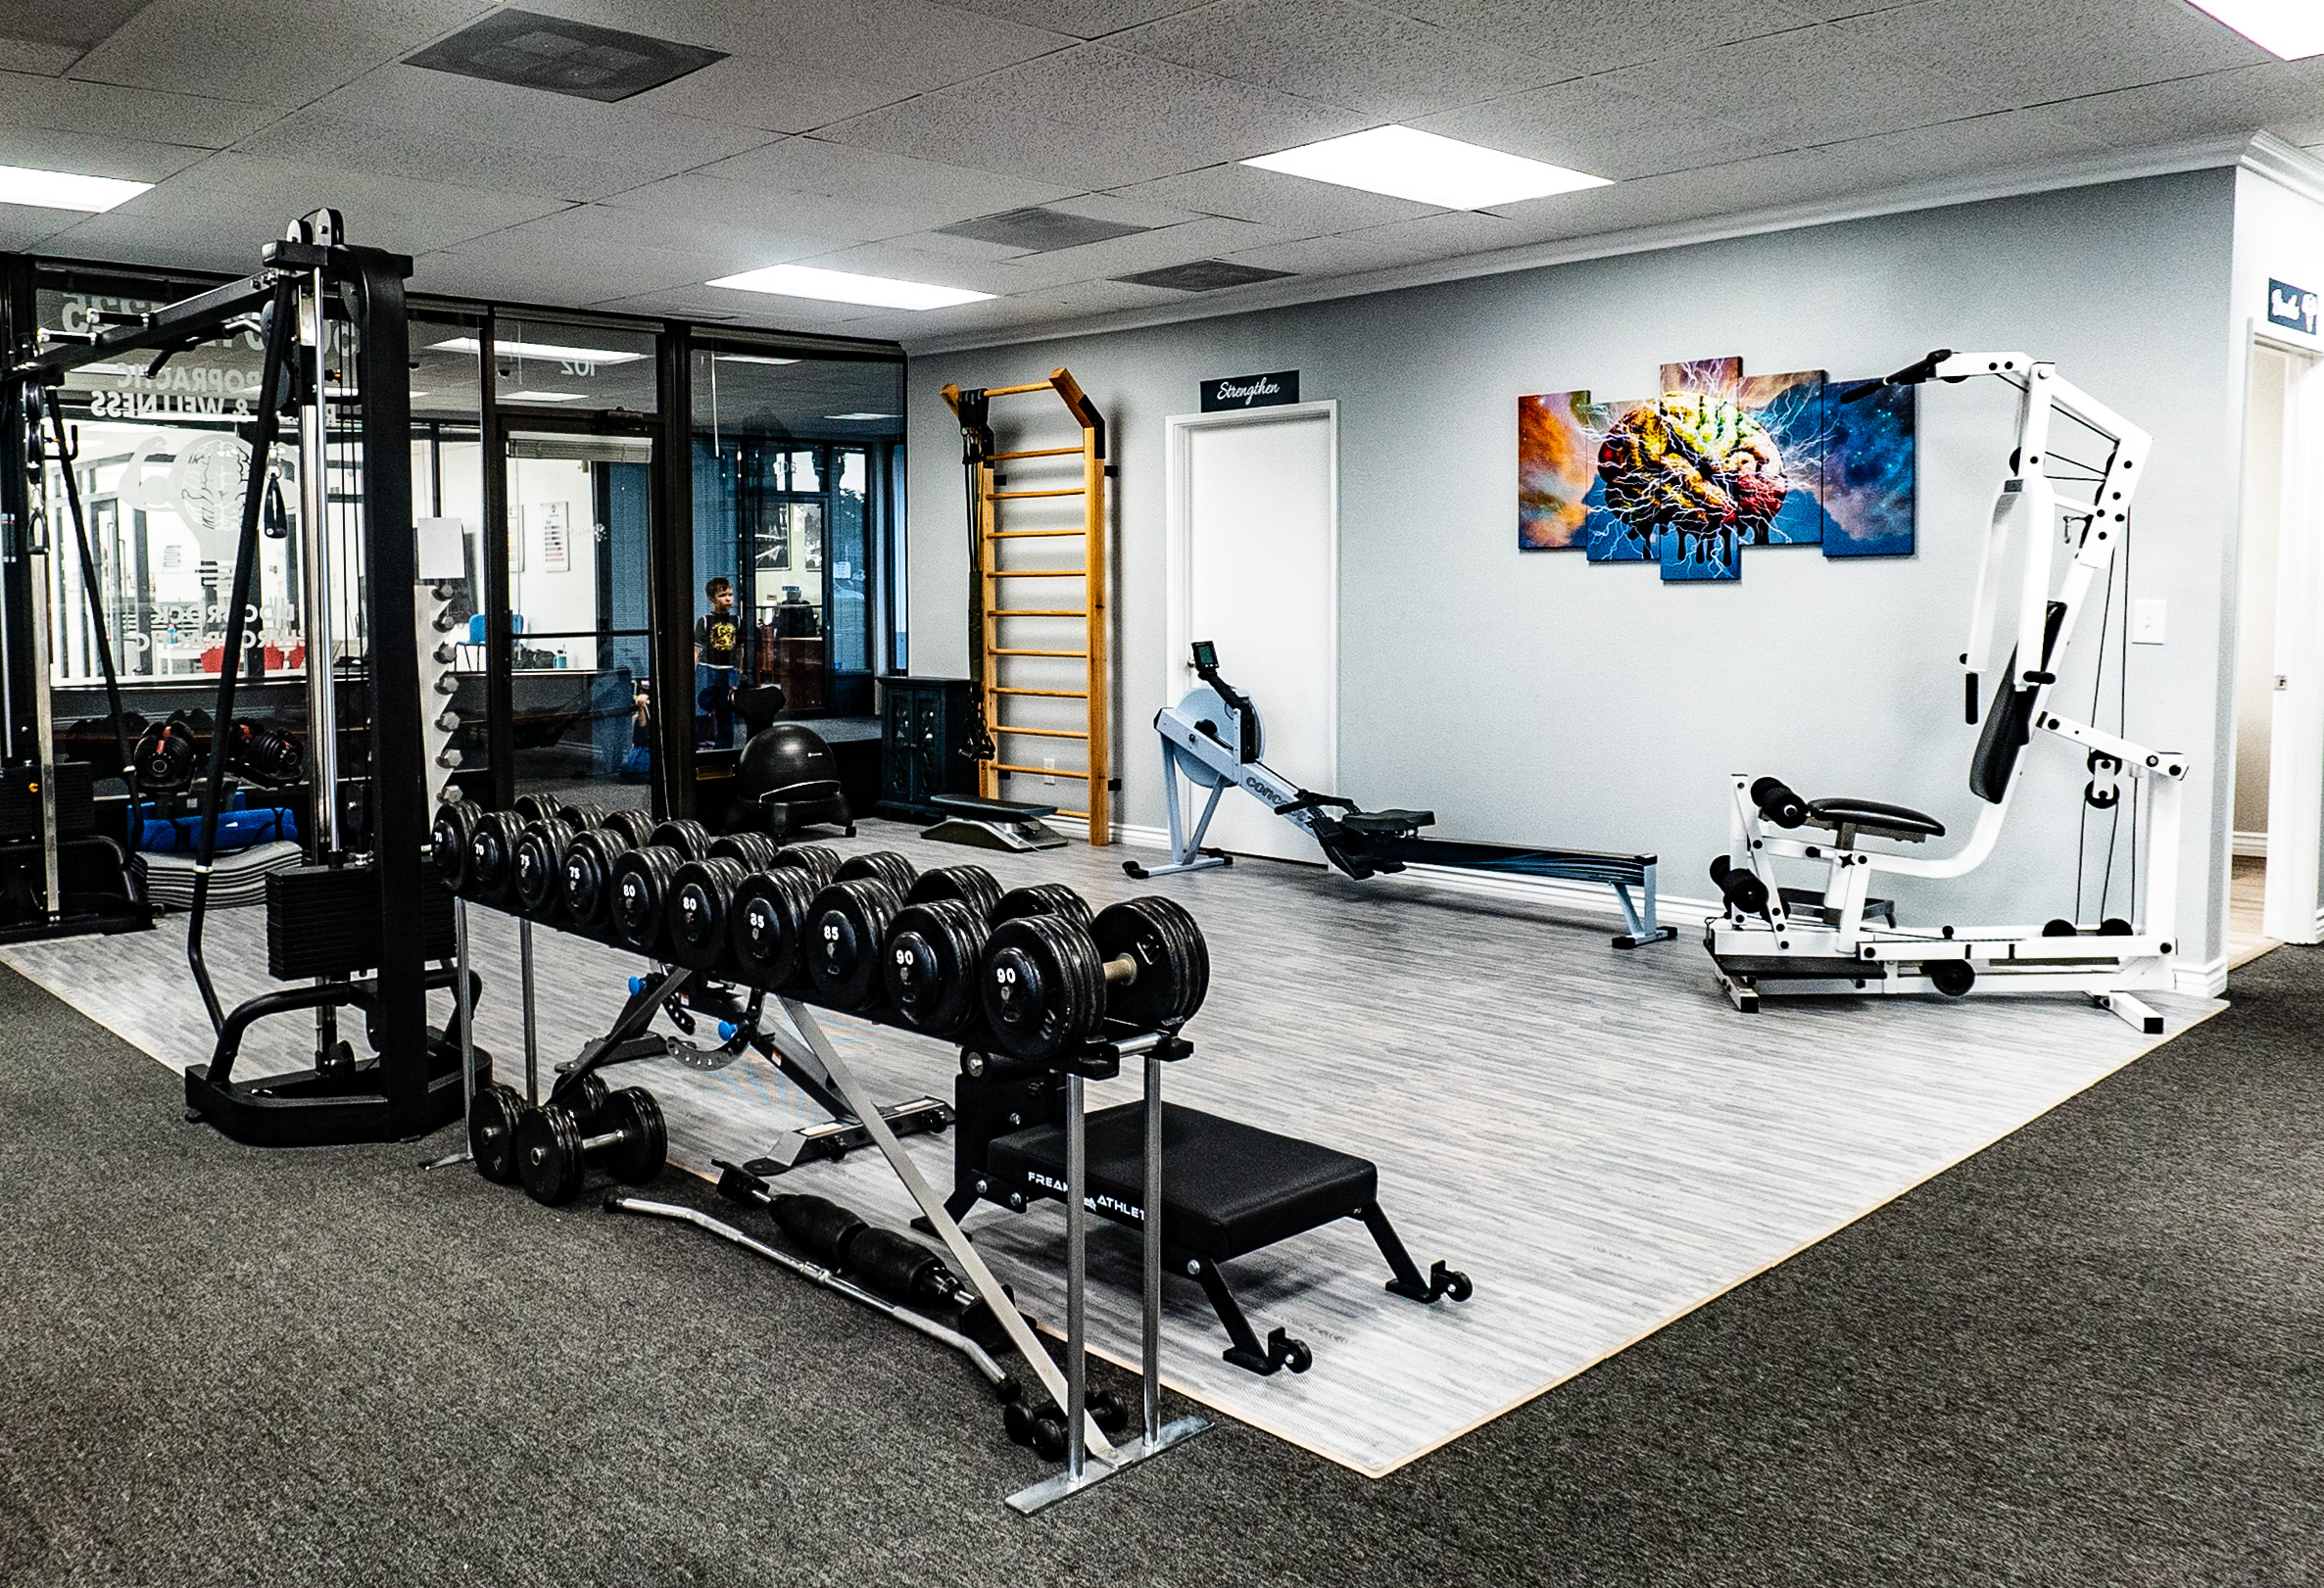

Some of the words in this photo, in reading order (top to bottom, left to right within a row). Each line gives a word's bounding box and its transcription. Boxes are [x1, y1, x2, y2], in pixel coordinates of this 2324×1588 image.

[1217, 376, 1280, 406] Strengthen
[474, 843, 485, 856] 70
[569, 866, 580, 880] 75
[623, 884, 636, 897] 80
[682, 896, 698, 911] 80
[750, 912, 765, 929] 85
[823, 925, 840, 940] 85
[896, 949, 914, 966] 90
[996, 967, 1016, 984] 90
[1097, 1194, 1144, 1221] ATHLET
